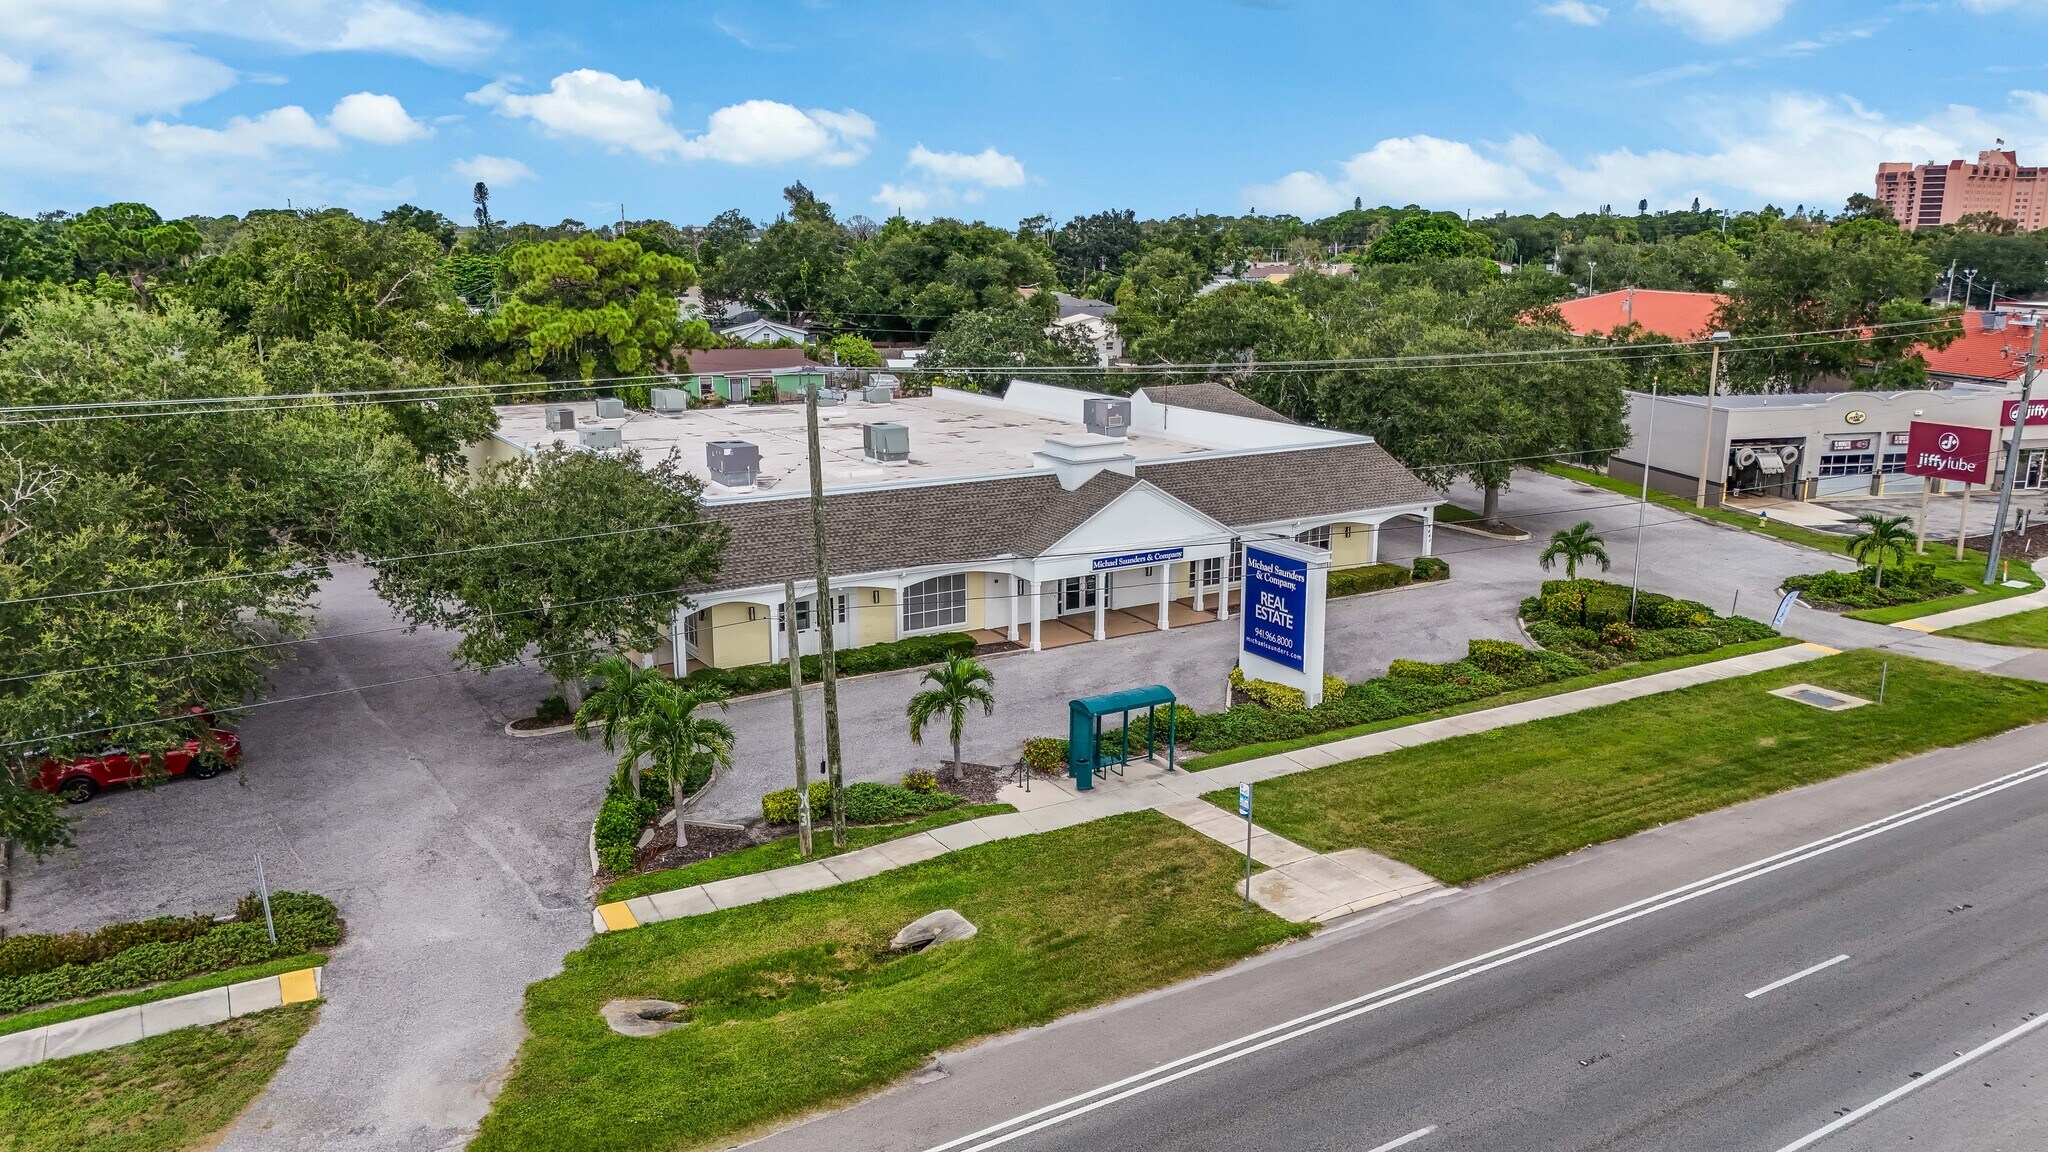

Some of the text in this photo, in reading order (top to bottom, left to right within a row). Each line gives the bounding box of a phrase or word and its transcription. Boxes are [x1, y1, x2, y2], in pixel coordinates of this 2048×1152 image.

[2026, 405, 2048, 419] jiffy
[1917, 453, 1976, 472] jiffy lube
[1094, 552, 1182, 568] Michael Saunders & Company
[1248, 558, 1305, 583] Michael Saunders
[1256, 570, 1263, 580] &
[1261, 592, 1288, 613] REAL
[1255, 605, 1293, 629] ESTATE
[1246, 636, 1302, 660] michaelsaunders.com
[1255, 628, 1293, 648] 941.966.8000
